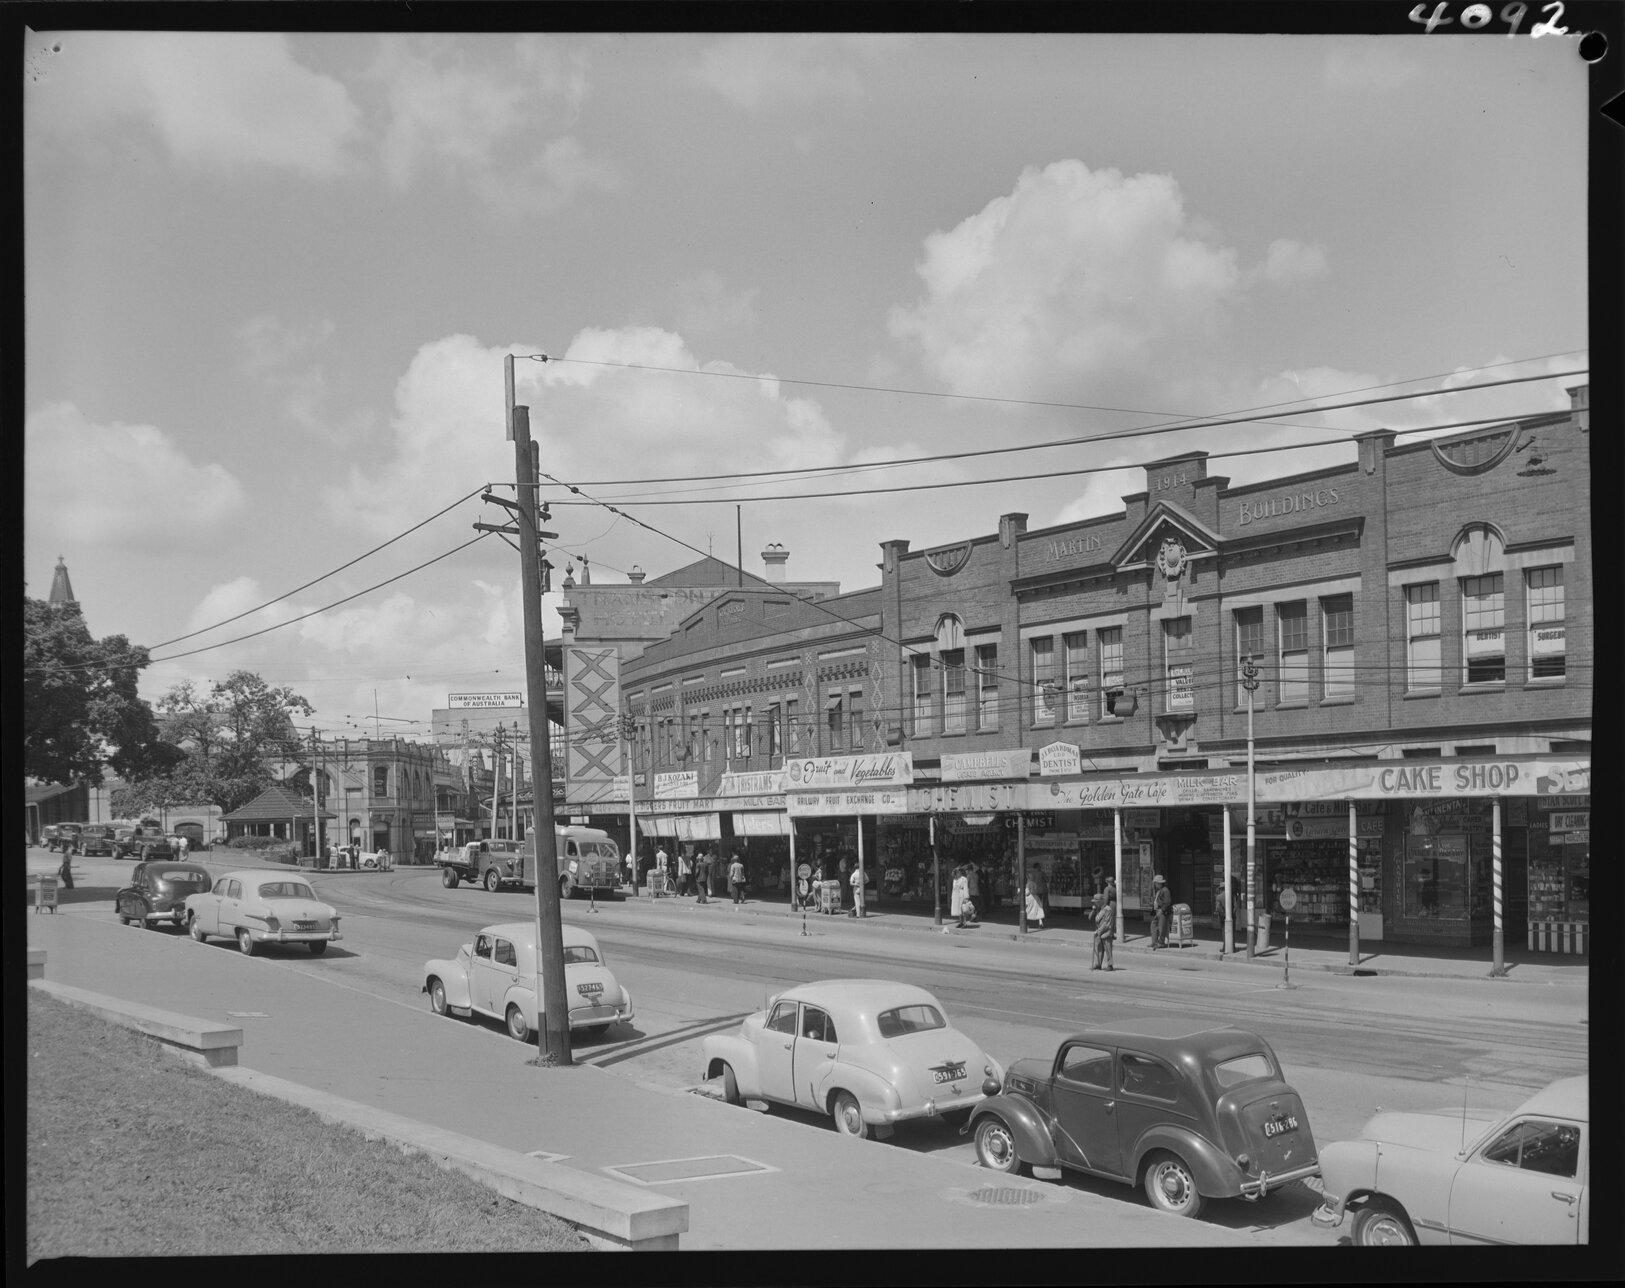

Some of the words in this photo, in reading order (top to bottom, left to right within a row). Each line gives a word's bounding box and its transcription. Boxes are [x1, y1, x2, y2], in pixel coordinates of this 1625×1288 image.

[1157, 472, 1188, 491] 1914
[1239, 487, 1339, 526] BUILDINGS
[1046, 535, 1102, 561] MARTIN
[1043, 759, 1077, 768] DENTIST
[803, 760, 832, 784] Fruit
[833, 761, 849, 775] and
[849, 756, 896, 785] Vegetables
[1177, 778, 1204, 788] MILK
[1211, 775, 1238, 787] BAR
[1265, 777, 1278, 785] FOR
[1379, 766, 1442, 793] CAKE
[1454, 764, 1519, 791] SHOP
[743, 798, 764, 806] MILK
[767, 797, 787, 806] BAR
[797, 796, 820, 805] RAILWAY
[825, 796, 840, 805] FRUIT
[846, 794, 875, 804] EXCHANGE
[922, 785, 1014, 811] CHEMIST
[1079, 786, 1117, 806] Golden
[1121, 784, 1144, 805] Gate
[668, 801, 690, 811] FRUIT
[693, 799, 714, 810] MART
[1305, 801, 1325, 814] Cafe
[1361, 820, 1384, 833] CAFE
